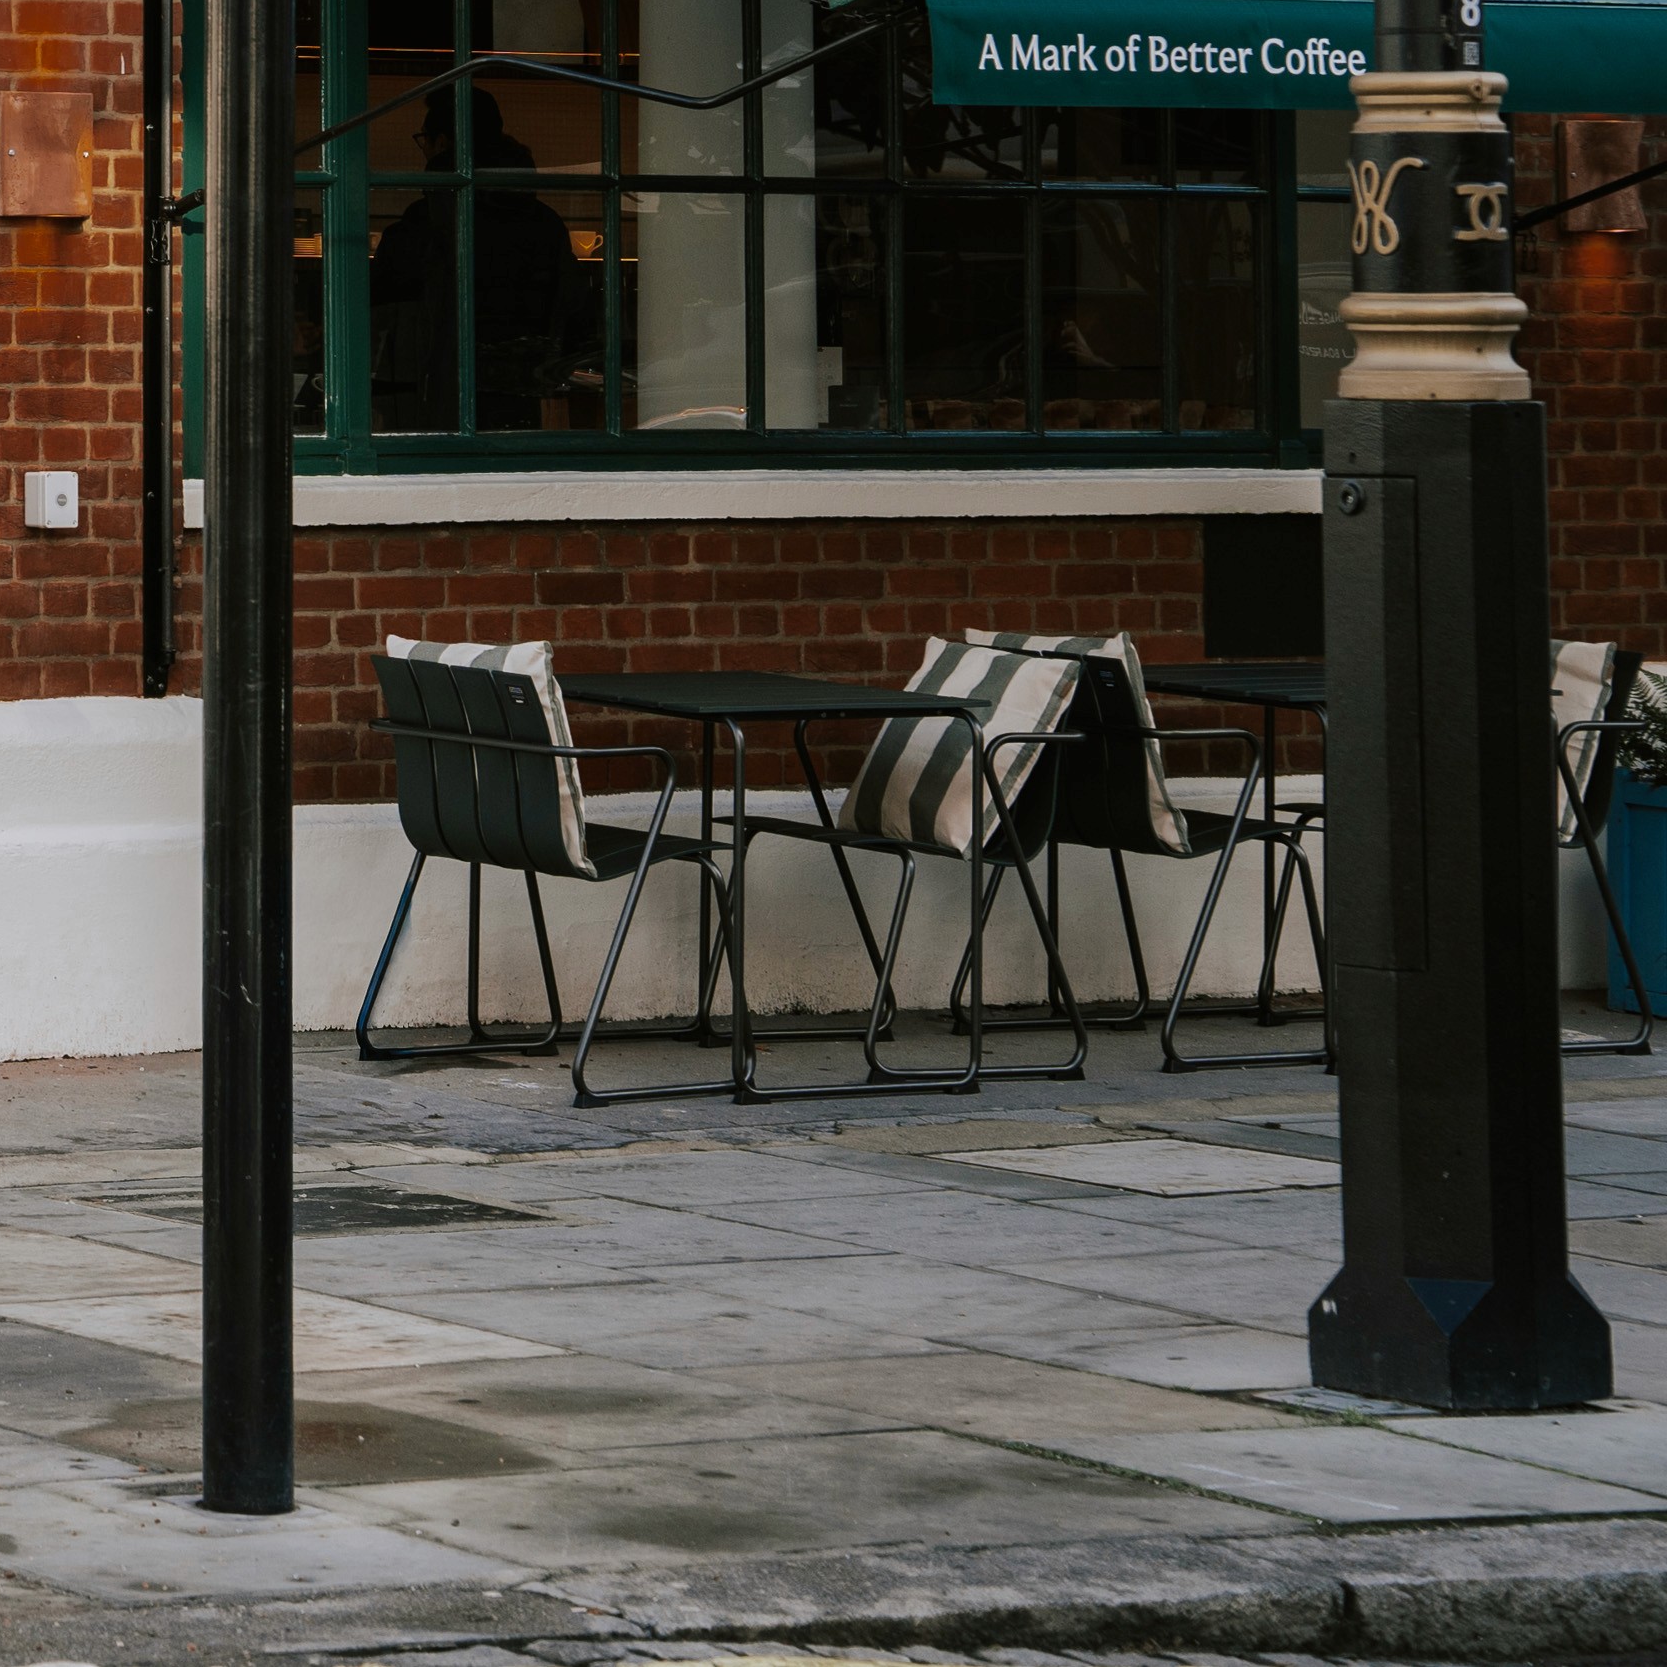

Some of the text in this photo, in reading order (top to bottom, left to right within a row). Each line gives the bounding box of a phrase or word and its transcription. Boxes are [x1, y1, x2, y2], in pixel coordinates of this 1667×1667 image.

[978, 33, 1366, 76] A Mark of Better Coffee
